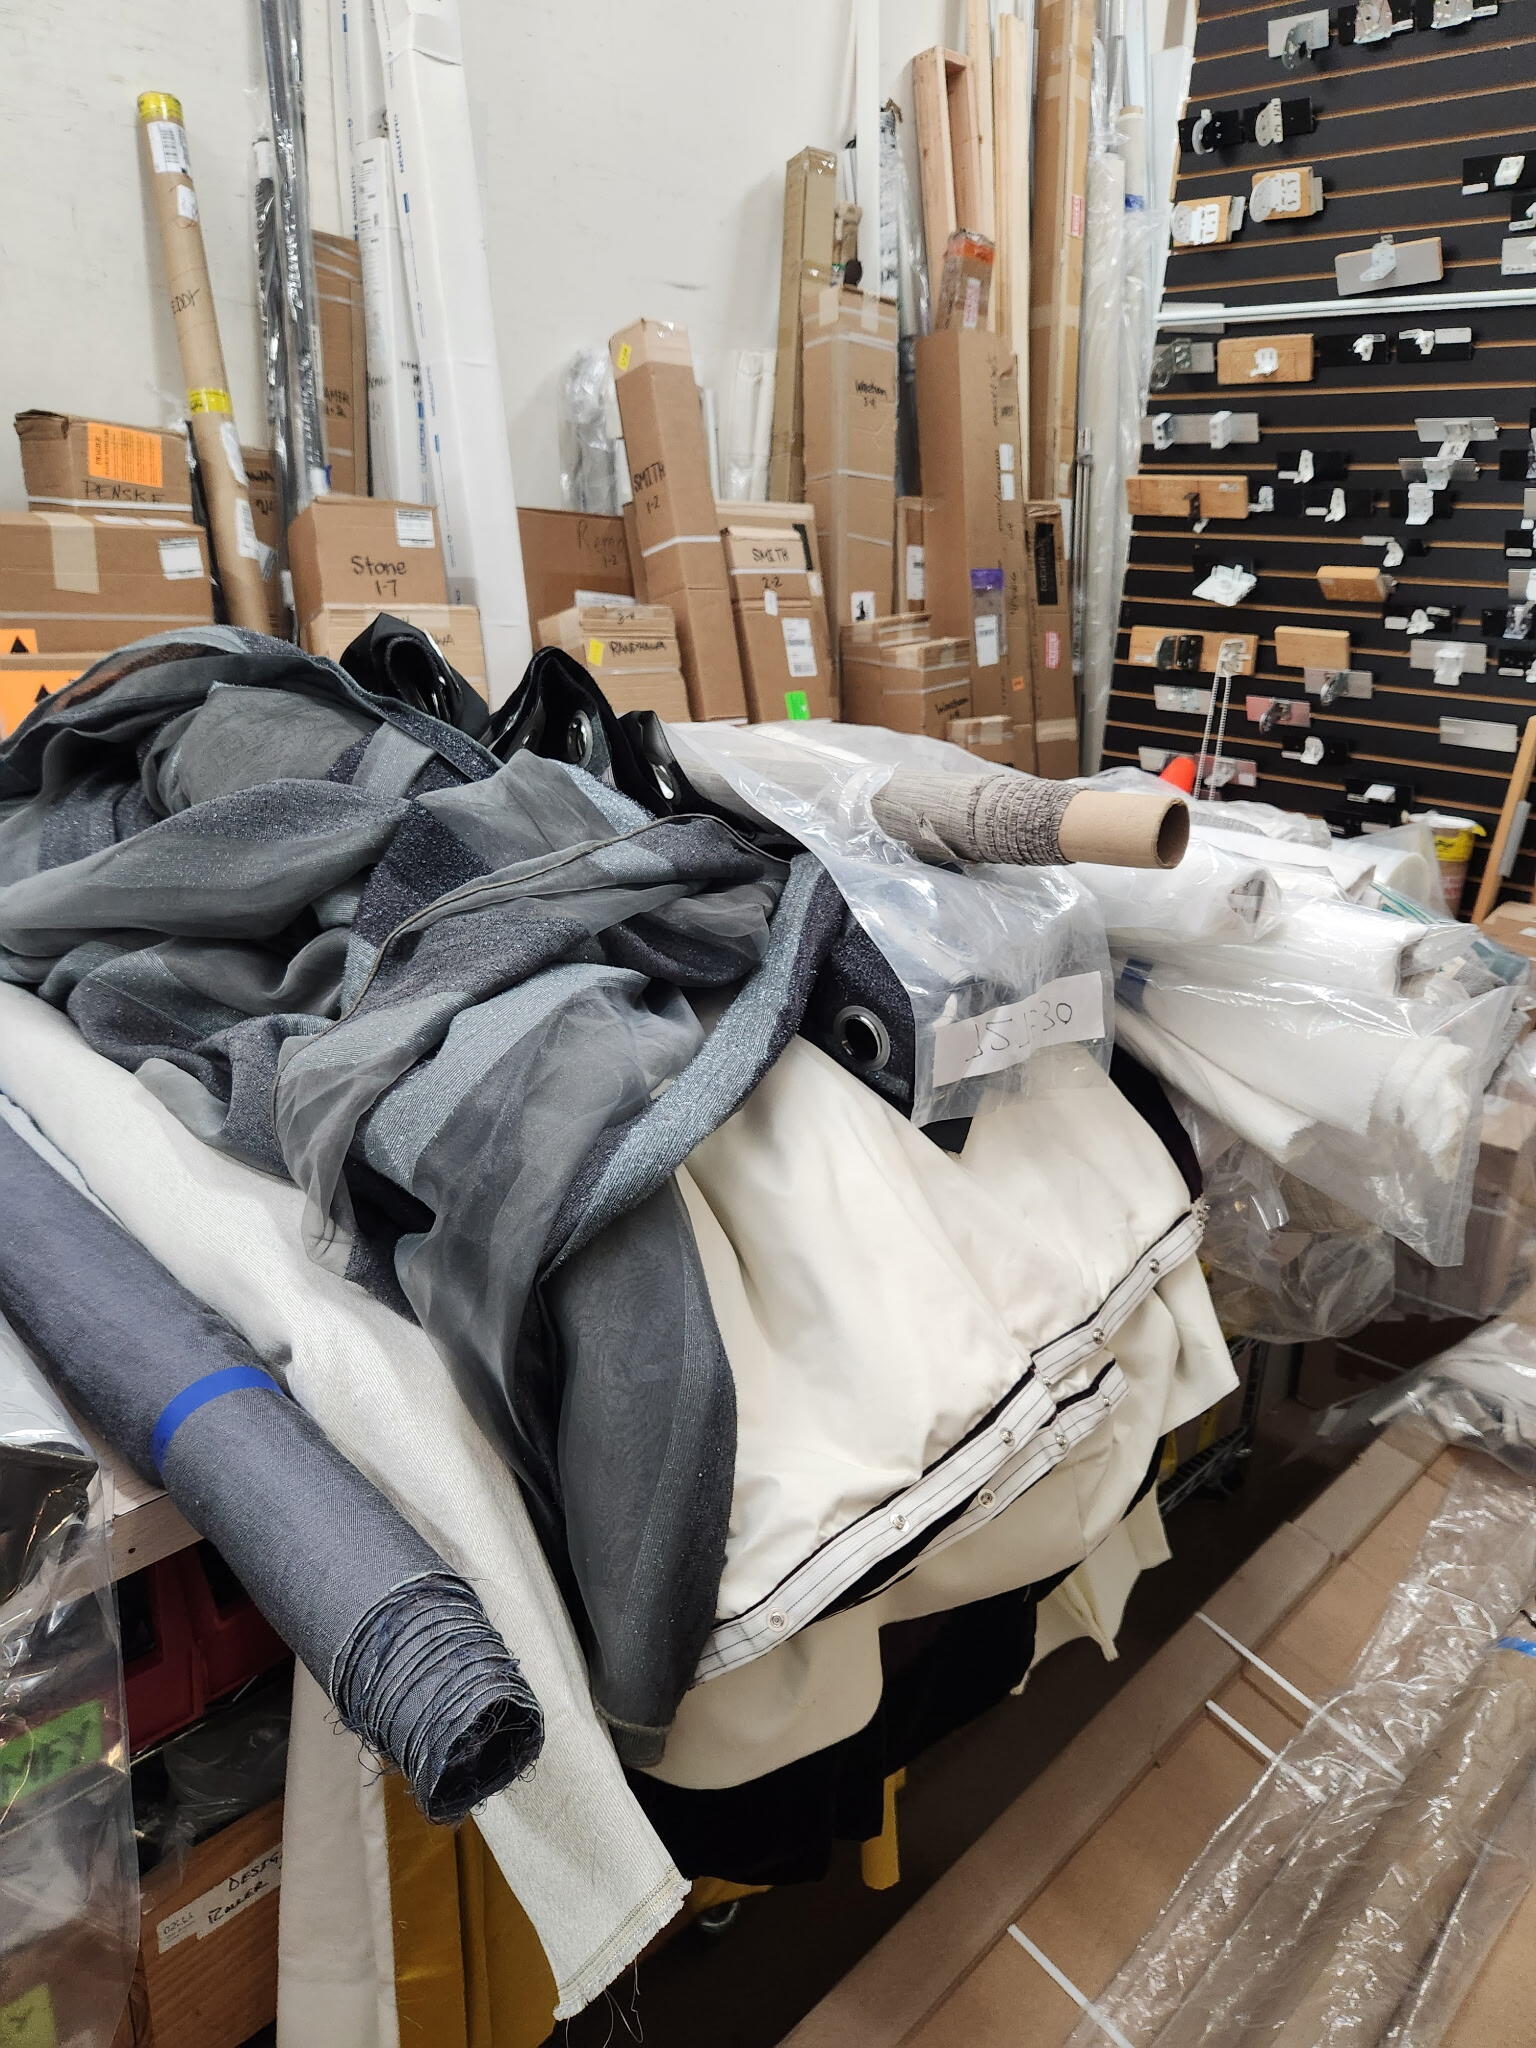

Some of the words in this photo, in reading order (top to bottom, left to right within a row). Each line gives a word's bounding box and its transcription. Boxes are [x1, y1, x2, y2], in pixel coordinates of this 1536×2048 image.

[634, 462, 666, 493] SMITH
[82, 480, 165, 503] PENSKE
[351, 555, 407, 576] Stone
[752, 548, 790, 563] SMITH
[375, 579, 398, 598] 1-7
